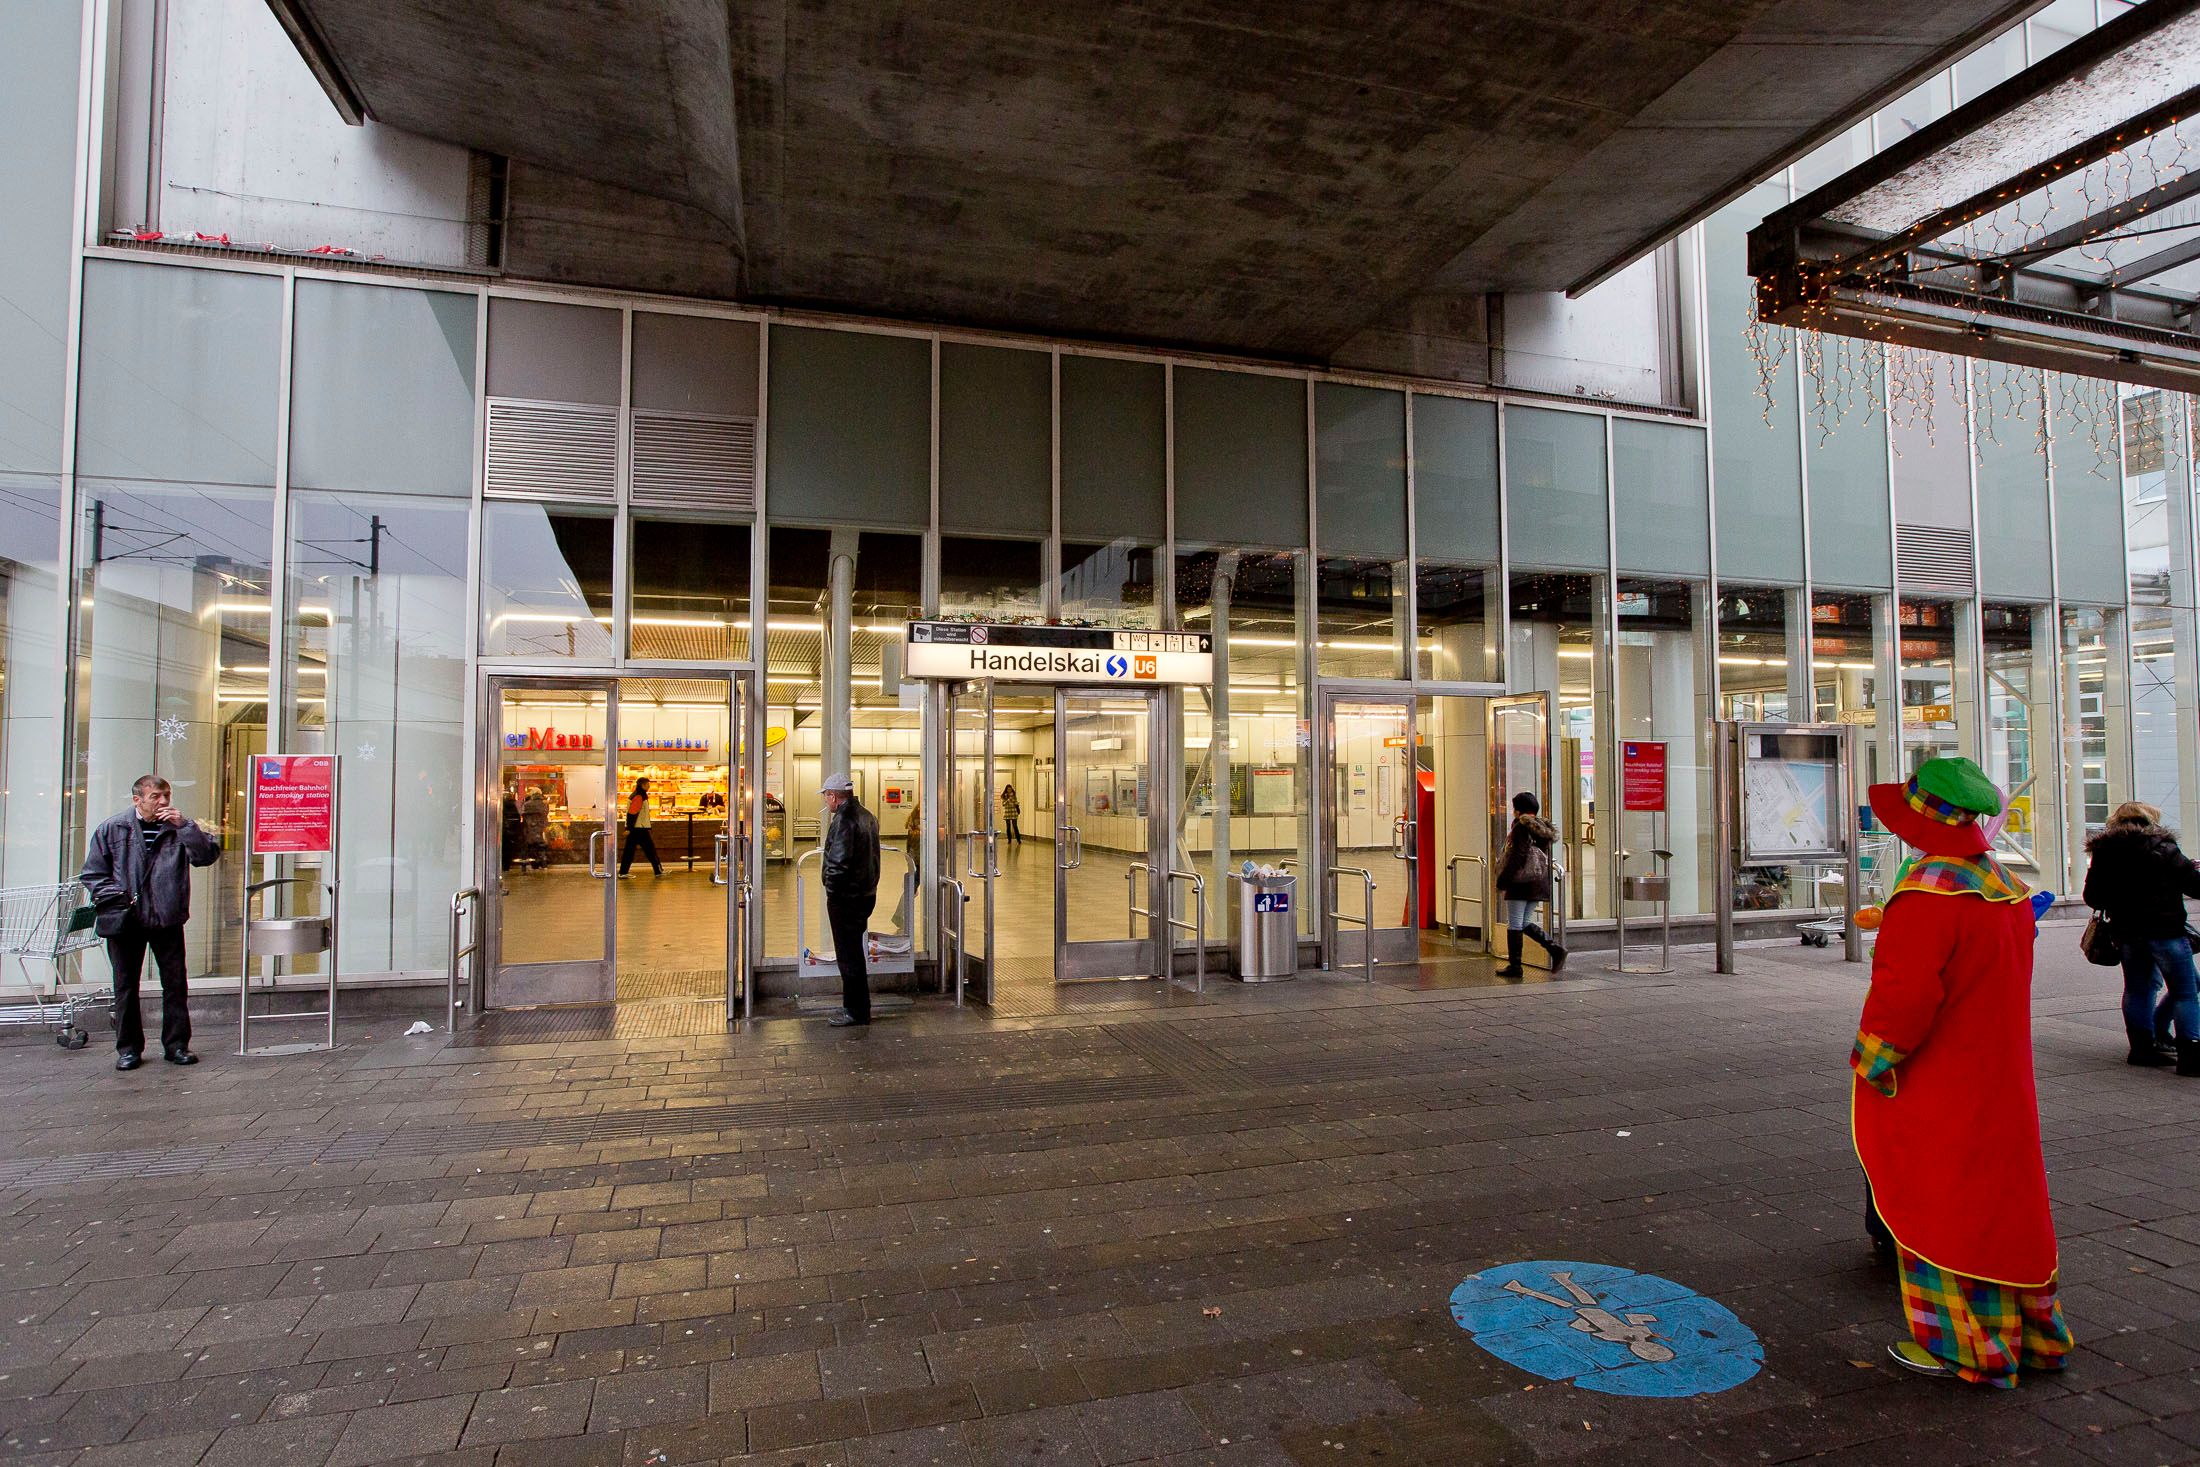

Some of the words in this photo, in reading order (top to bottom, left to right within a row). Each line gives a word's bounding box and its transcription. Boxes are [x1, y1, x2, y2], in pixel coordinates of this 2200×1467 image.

[1132, 634, 1147, 642] WC
[970, 649, 1100, 673] Handelskai
[1135, 660, 1156, 674] U6
[275, 792, 305, 800] smoking
